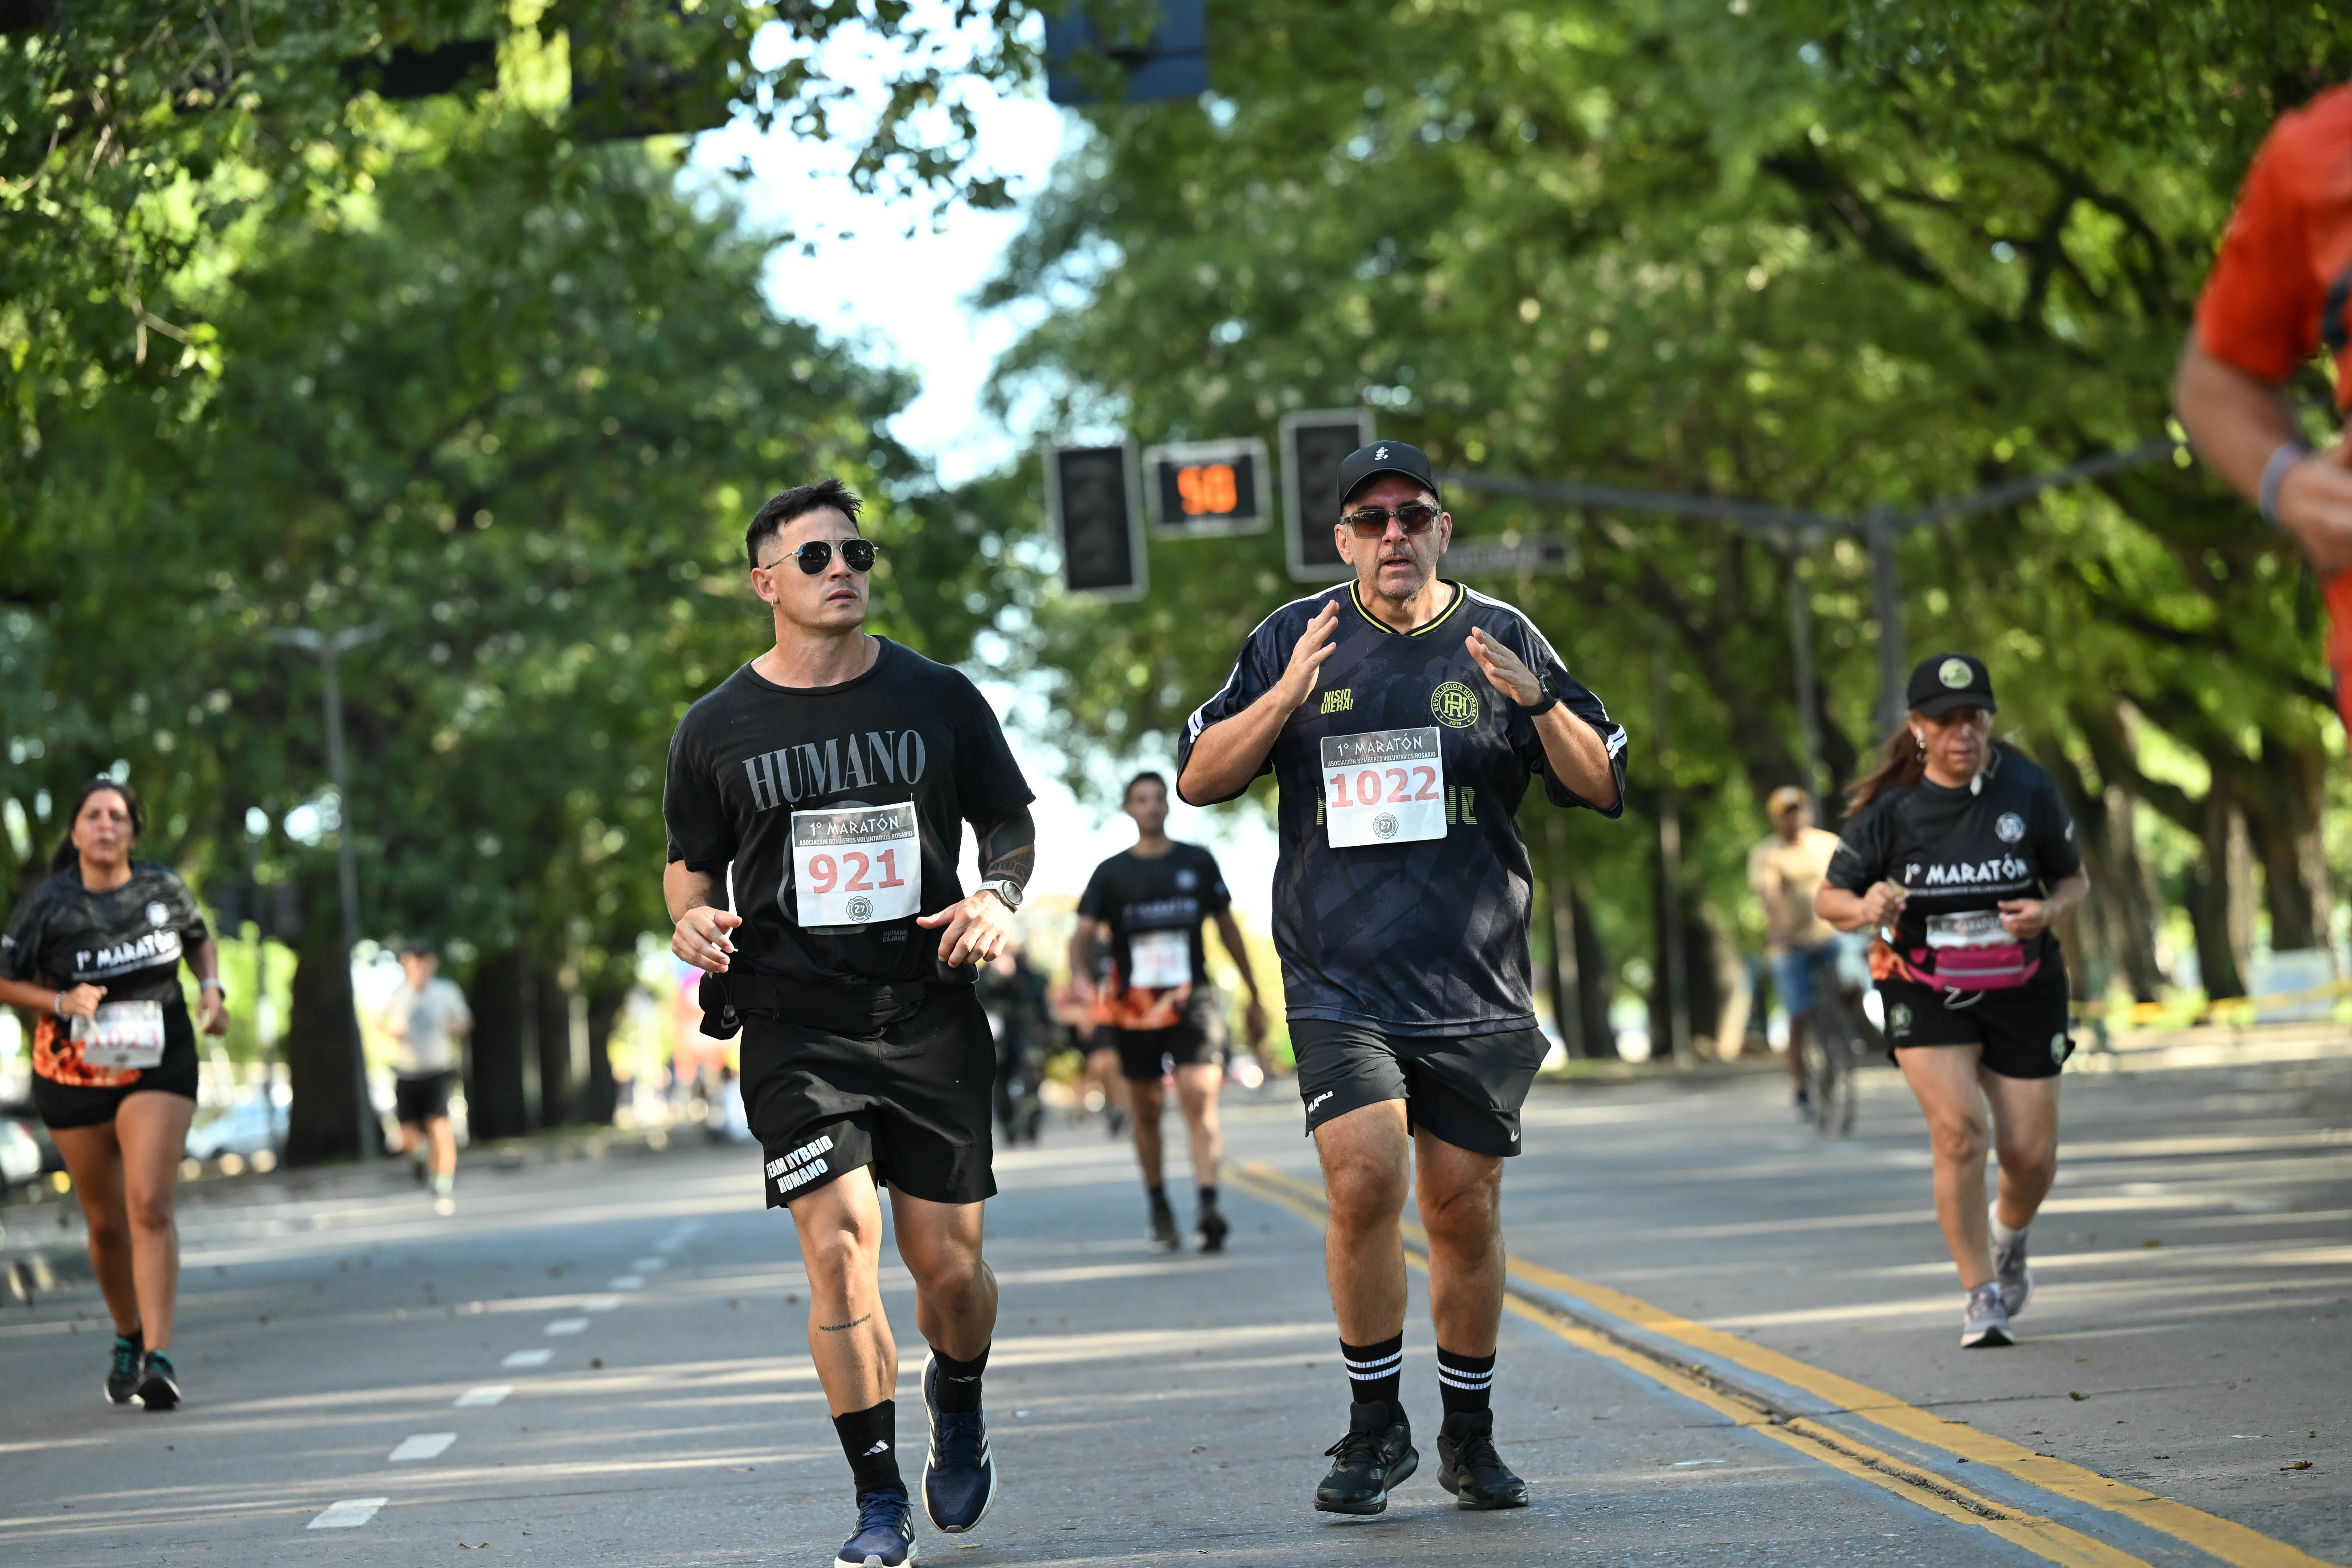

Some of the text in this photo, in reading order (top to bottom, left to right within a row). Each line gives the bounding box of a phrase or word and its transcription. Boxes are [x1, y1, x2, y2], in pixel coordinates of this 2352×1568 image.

[1433, 684, 1477, 717] REVOLUCION HUMANA
[1355, 733, 1422, 755] MARATÓN
[742, 730, 926, 812] HUMANO
[1328, 758, 1356, 767] ASOCIACIÓN
[1330, 766, 1439, 808] 1022
[827, 813, 900, 835] MARATÓN
[856, 834, 891, 843] VOLUNTARIOS
[891, 831, 913, 839] ROSARIO
[1381, 821, 1391, 830] 27
[808, 849, 904, 894] 921
[1925, 852, 2028, 886] MARATÓN
[854, 904, 865, 914] 27
[766, 1135, 834, 1180] TEAM HYBRID
[777, 1158, 828, 1194] HUMANO
